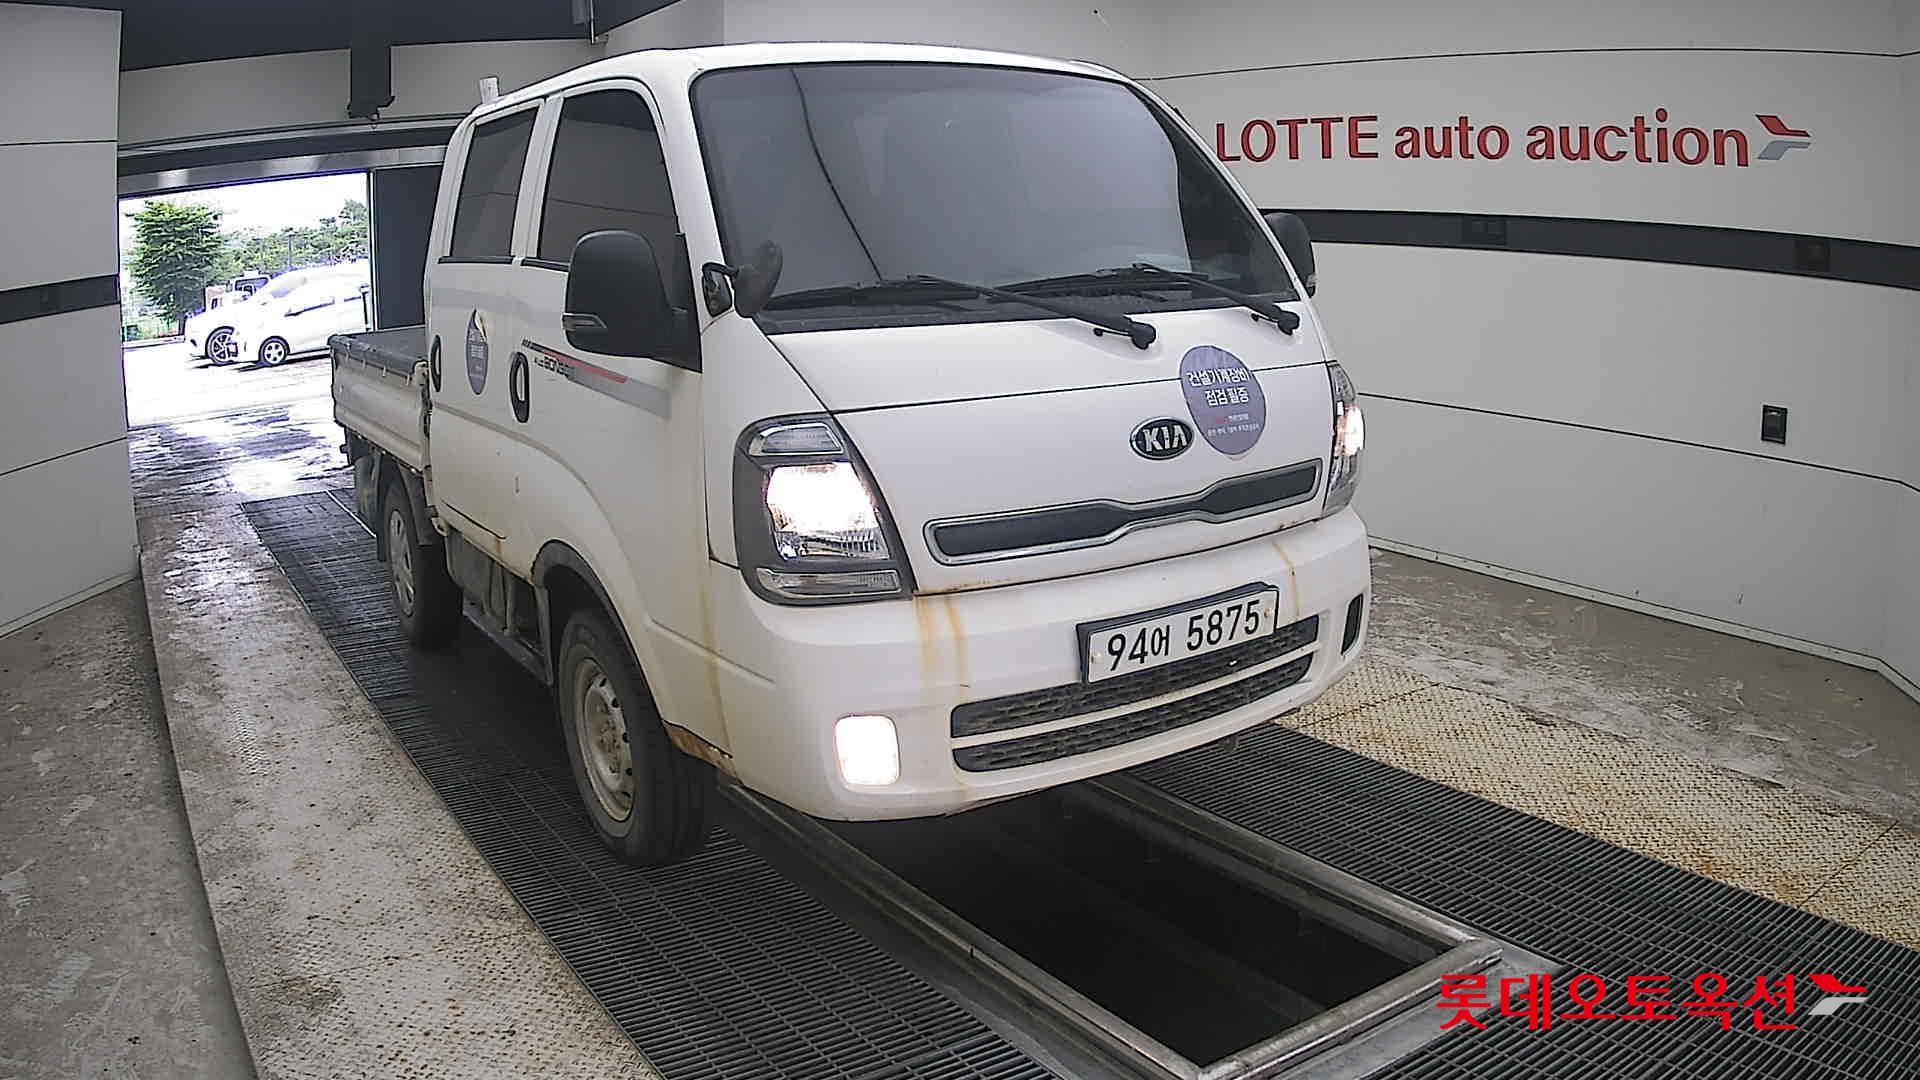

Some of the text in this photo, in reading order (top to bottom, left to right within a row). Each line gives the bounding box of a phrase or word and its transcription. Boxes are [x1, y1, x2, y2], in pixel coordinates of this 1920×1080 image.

[1216, 108, 1749, 167] LOTTE auto auction
[1143, 425, 1187, 451] KIA
[1107, 600, 1260, 672] 94어 5875
